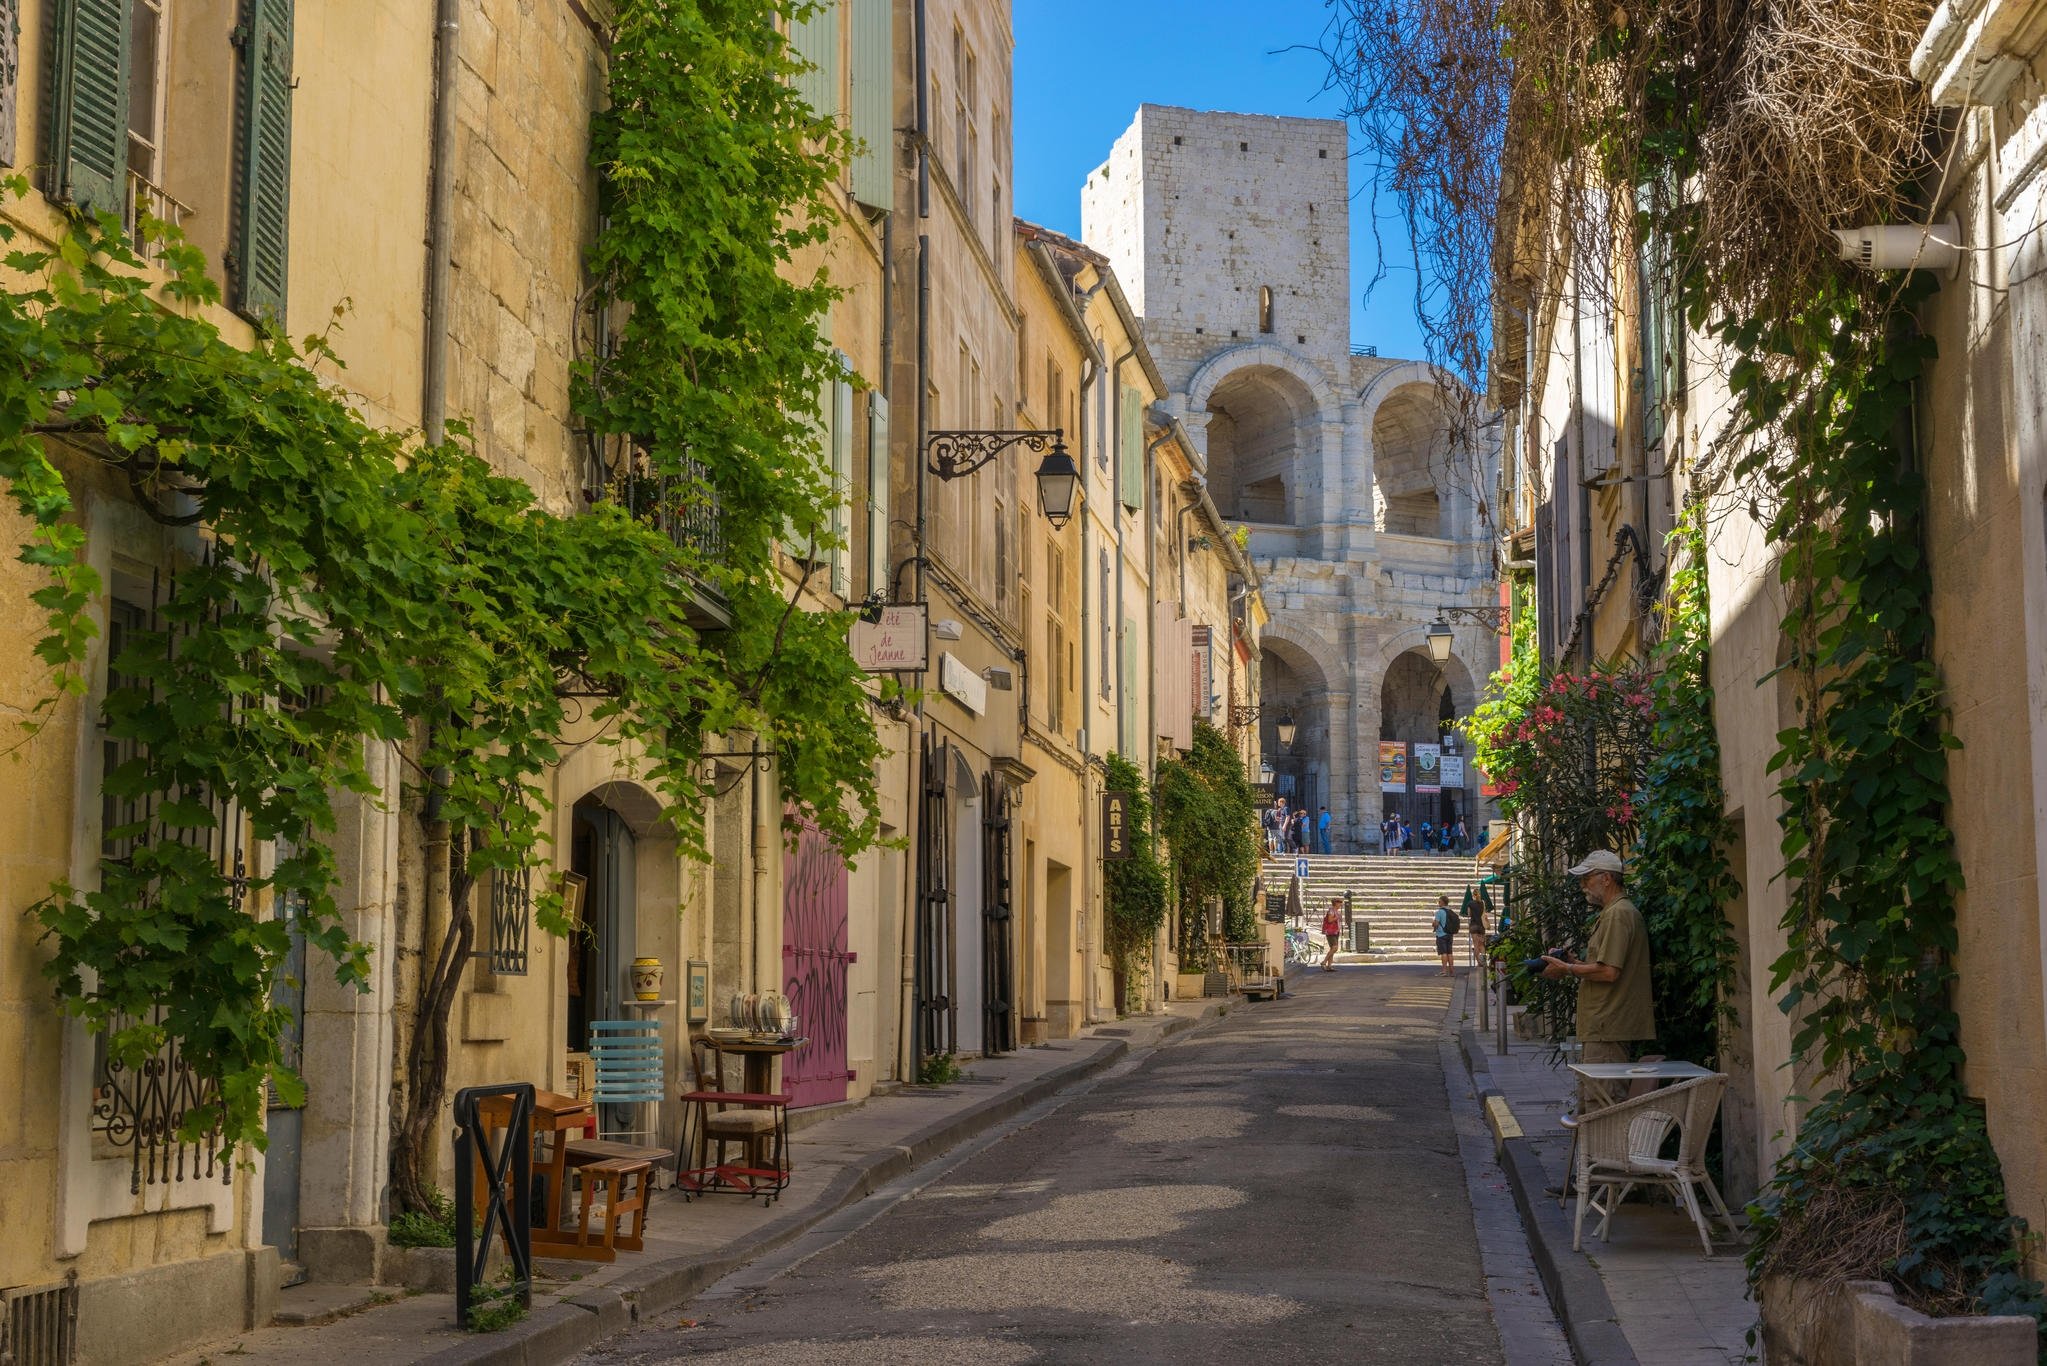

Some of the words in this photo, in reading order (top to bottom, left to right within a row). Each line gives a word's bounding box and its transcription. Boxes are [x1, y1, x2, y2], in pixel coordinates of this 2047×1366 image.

[881, 631, 893, 647] de
[869, 645, 905, 666] Jeanne
[1109, 799, 1121, 853] ARTS
